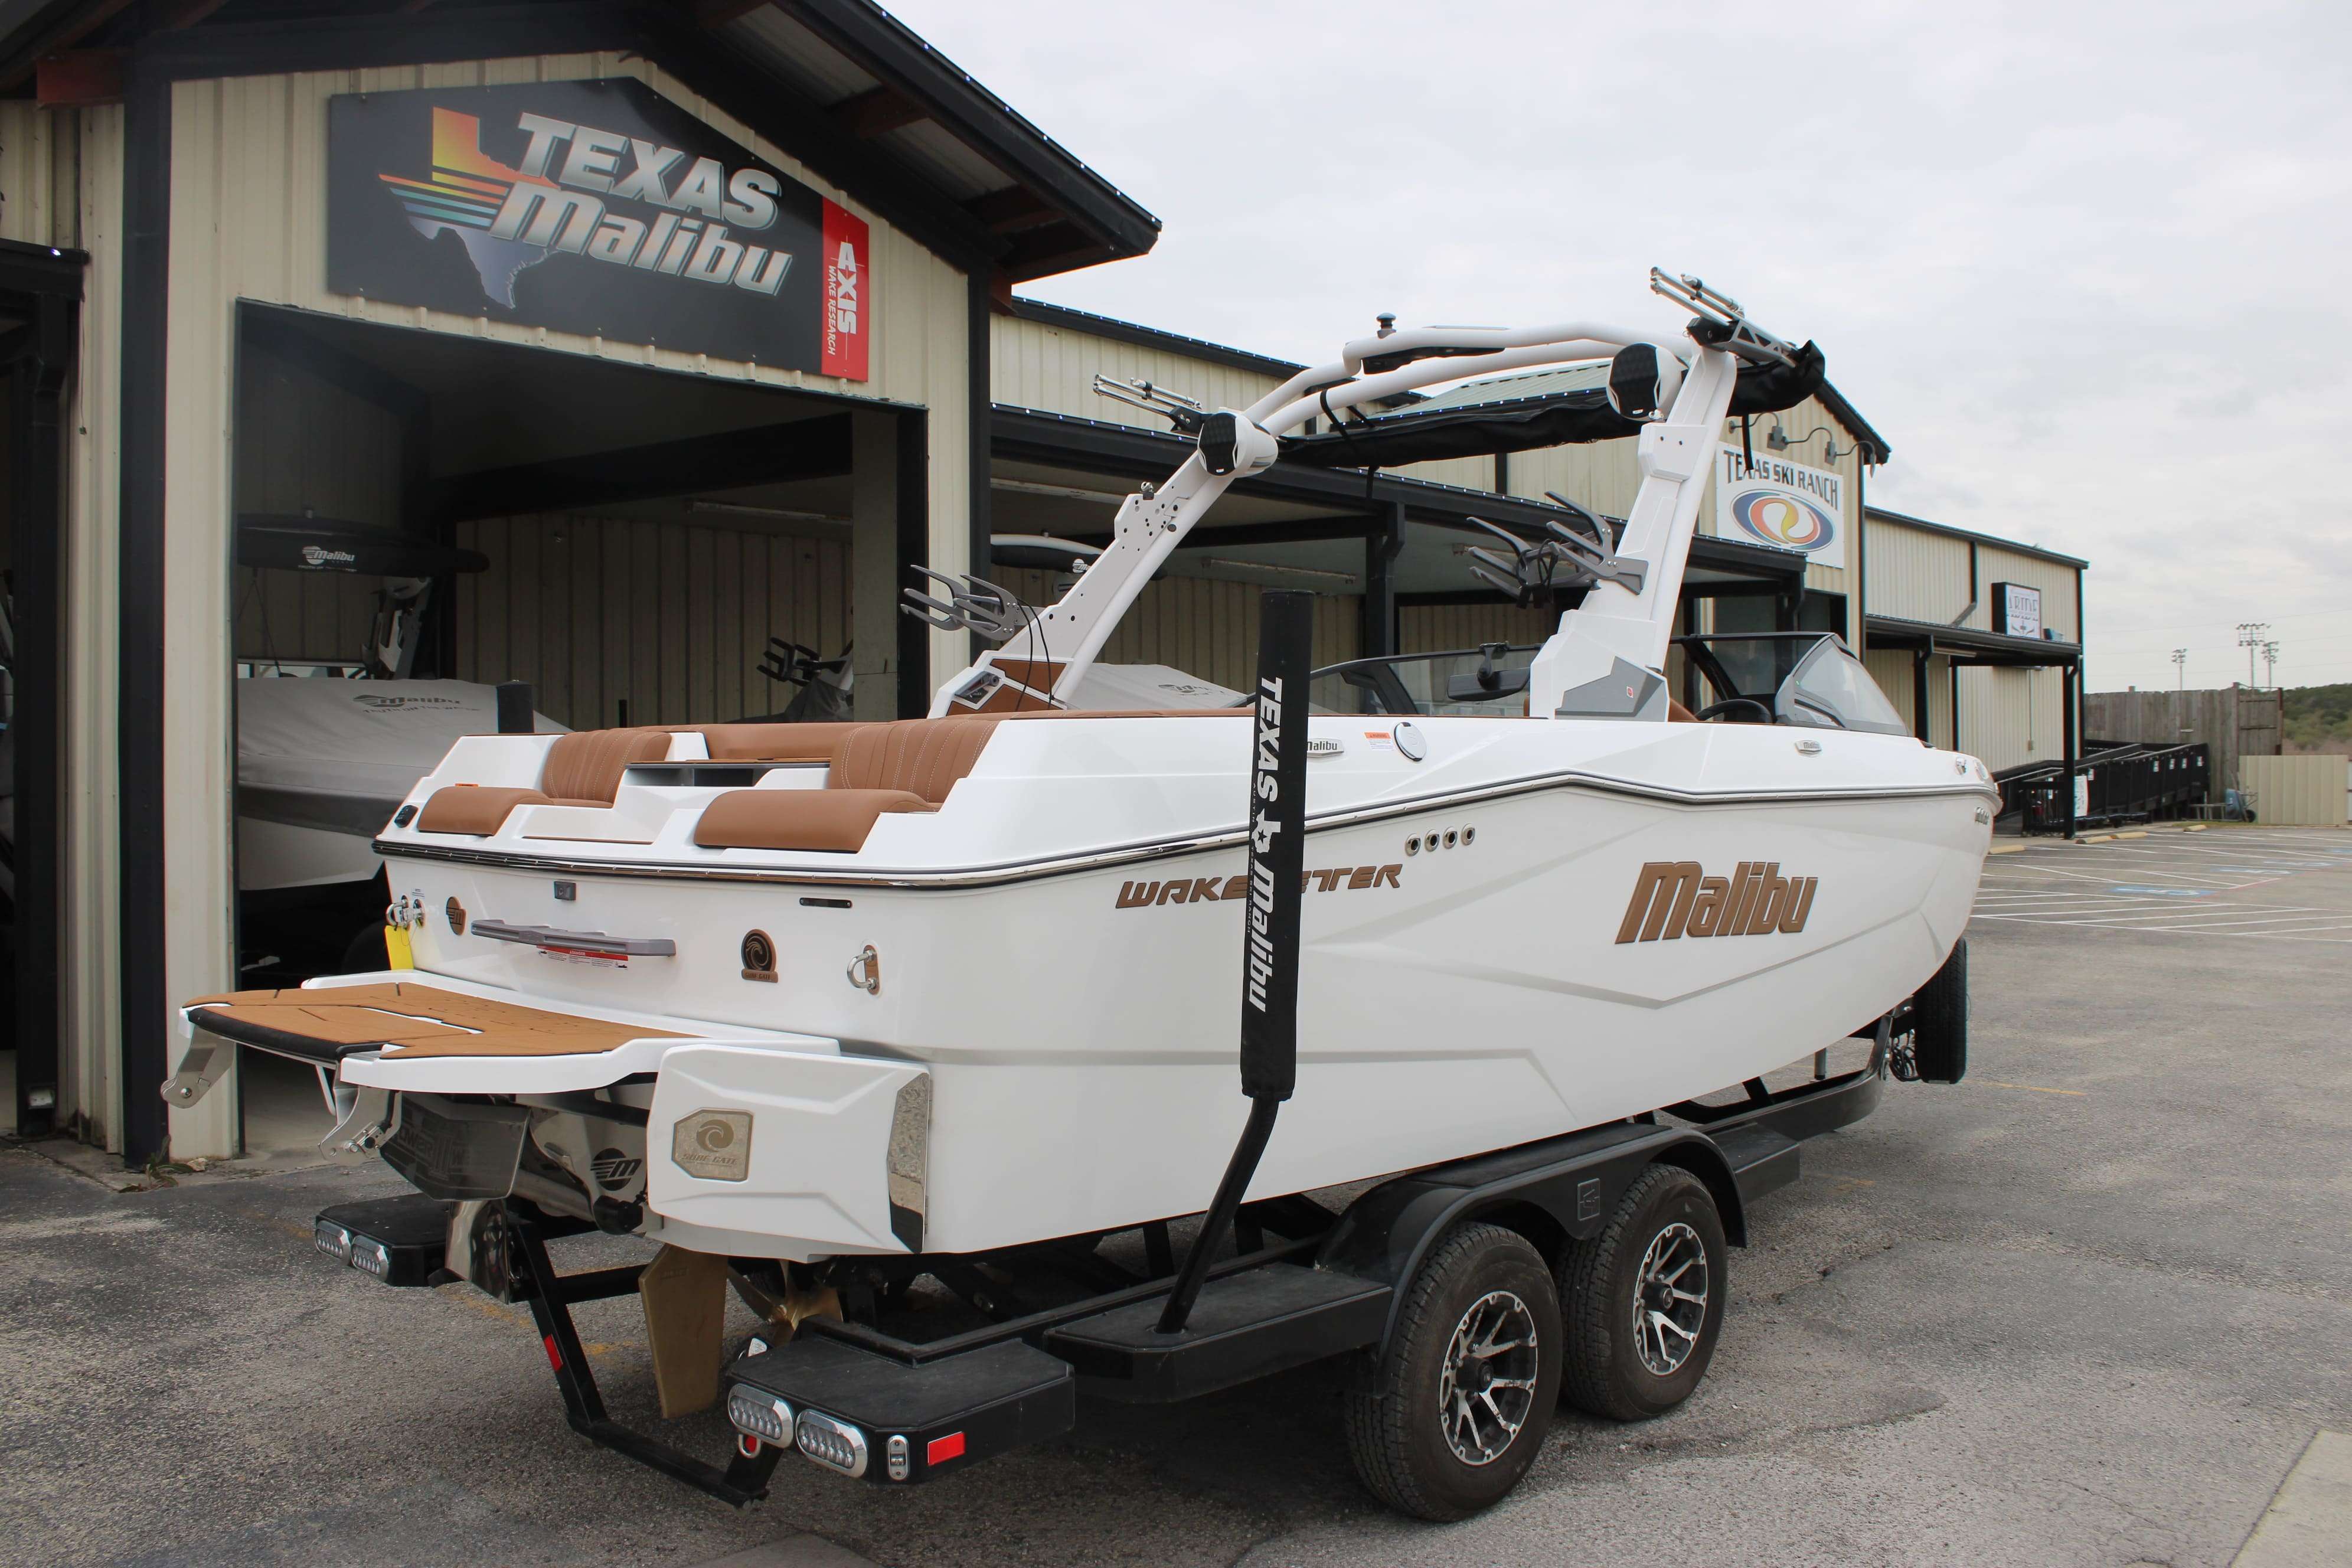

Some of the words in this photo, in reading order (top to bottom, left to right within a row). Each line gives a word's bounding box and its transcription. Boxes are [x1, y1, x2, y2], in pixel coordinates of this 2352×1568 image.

[517, 113, 781, 229] TEXAS
[488, 181, 792, 296] Malibu
[828, 265, 837, 297] WAKE
[827, 298, 836, 355] RESEARCH
[837, 241, 857, 335] AXIS
[1773, 464, 1794, 486] SKI
[1798, 470, 1838, 511] RANCH
[313, 550, 355, 561] Malibu
[1257, 677, 1282, 802] TEXAS
[1249, 858, 1274, 1012] Malibu
[1615, 861, 1818, 944] Malibu
